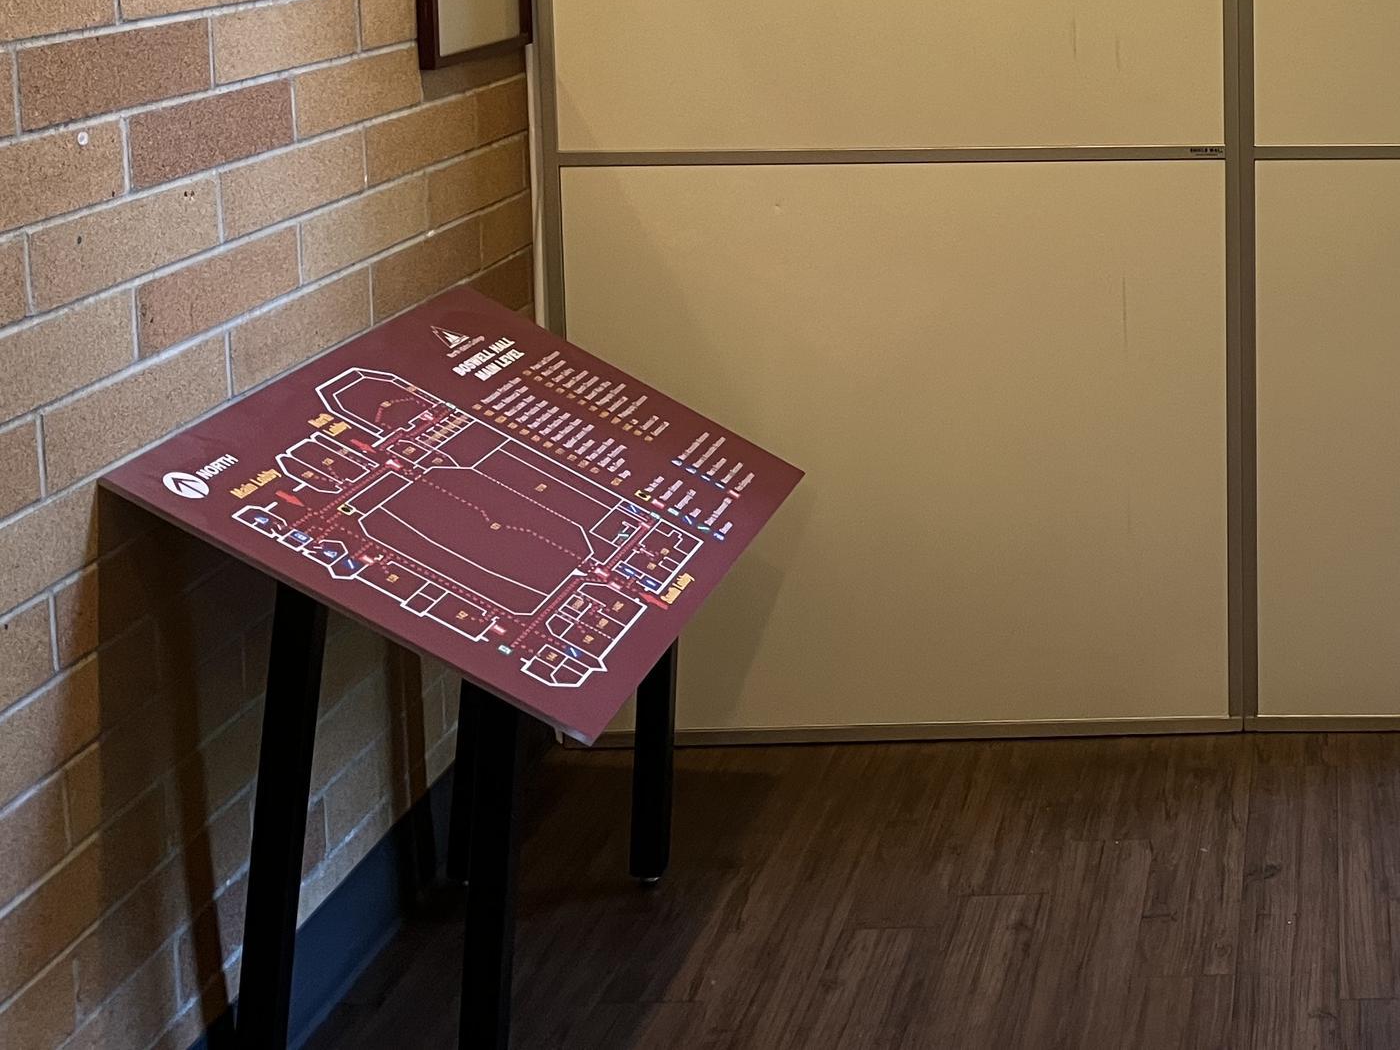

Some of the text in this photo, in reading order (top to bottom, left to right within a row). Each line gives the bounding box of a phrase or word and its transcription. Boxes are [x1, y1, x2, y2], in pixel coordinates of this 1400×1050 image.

[452, 349, 496, 377] BOSWELL
[488, 337, 515, 355] HALL
[474, 348, 525, 381] MAIN LEVEL
[322, 421, 352, 437] Lobby
[195, 453, 240, 480] NORTH
[229, 468, 282, 499] Main Lobby
